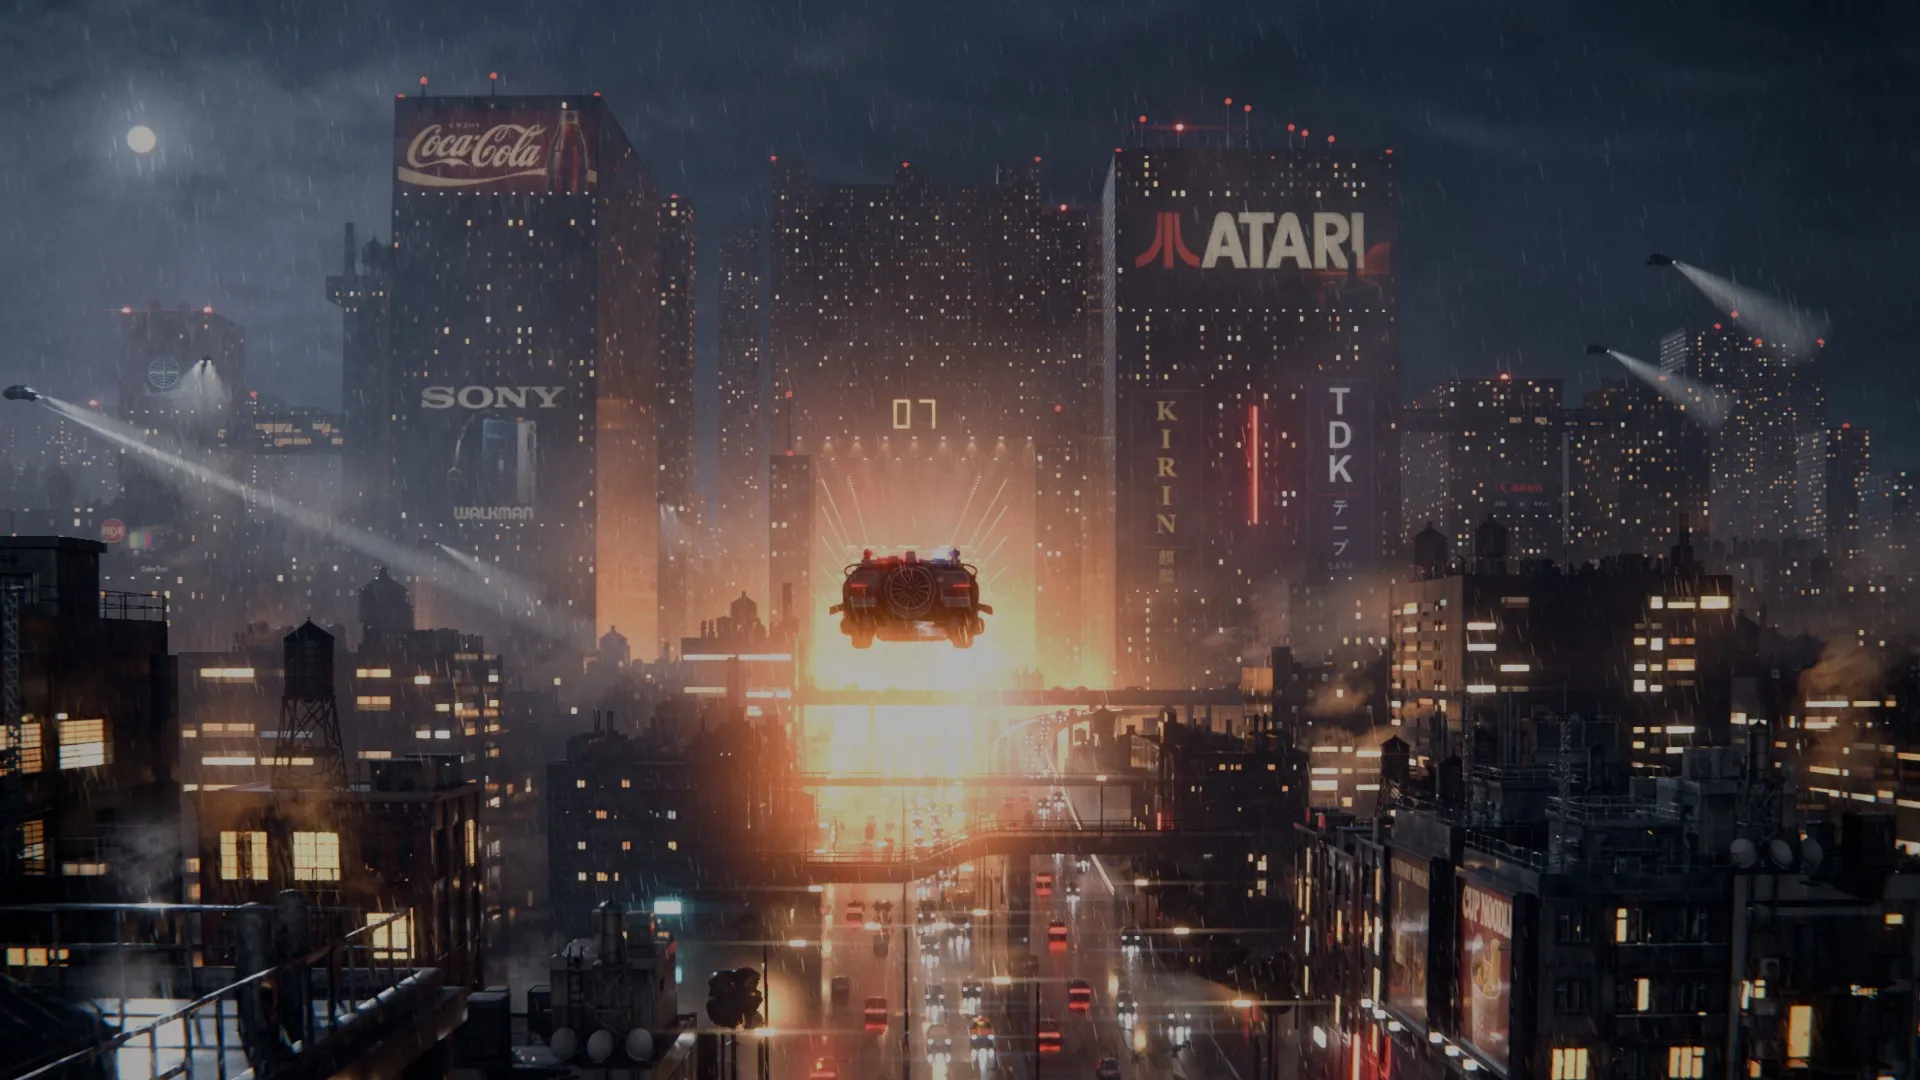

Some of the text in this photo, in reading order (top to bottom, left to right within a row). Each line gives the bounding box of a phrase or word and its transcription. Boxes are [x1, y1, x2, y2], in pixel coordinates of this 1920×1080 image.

[406, 123, 548, 168] Coca-Cola
[1201, 211, 1365, 269] ATARI
[421, 385, 566, 409] SONY
[893, 399, 936, 429] 07
[1328, 387, 1353, 482] TDK
[1155, 400, 1179, 534] KIRIN
[1499, 481, 1543, 493] Canon
[453, 506, 534, 520] WALKMAN
[1332, 499, 1349, 556] テープ
[1462, 885, 1480, 923] CUP
